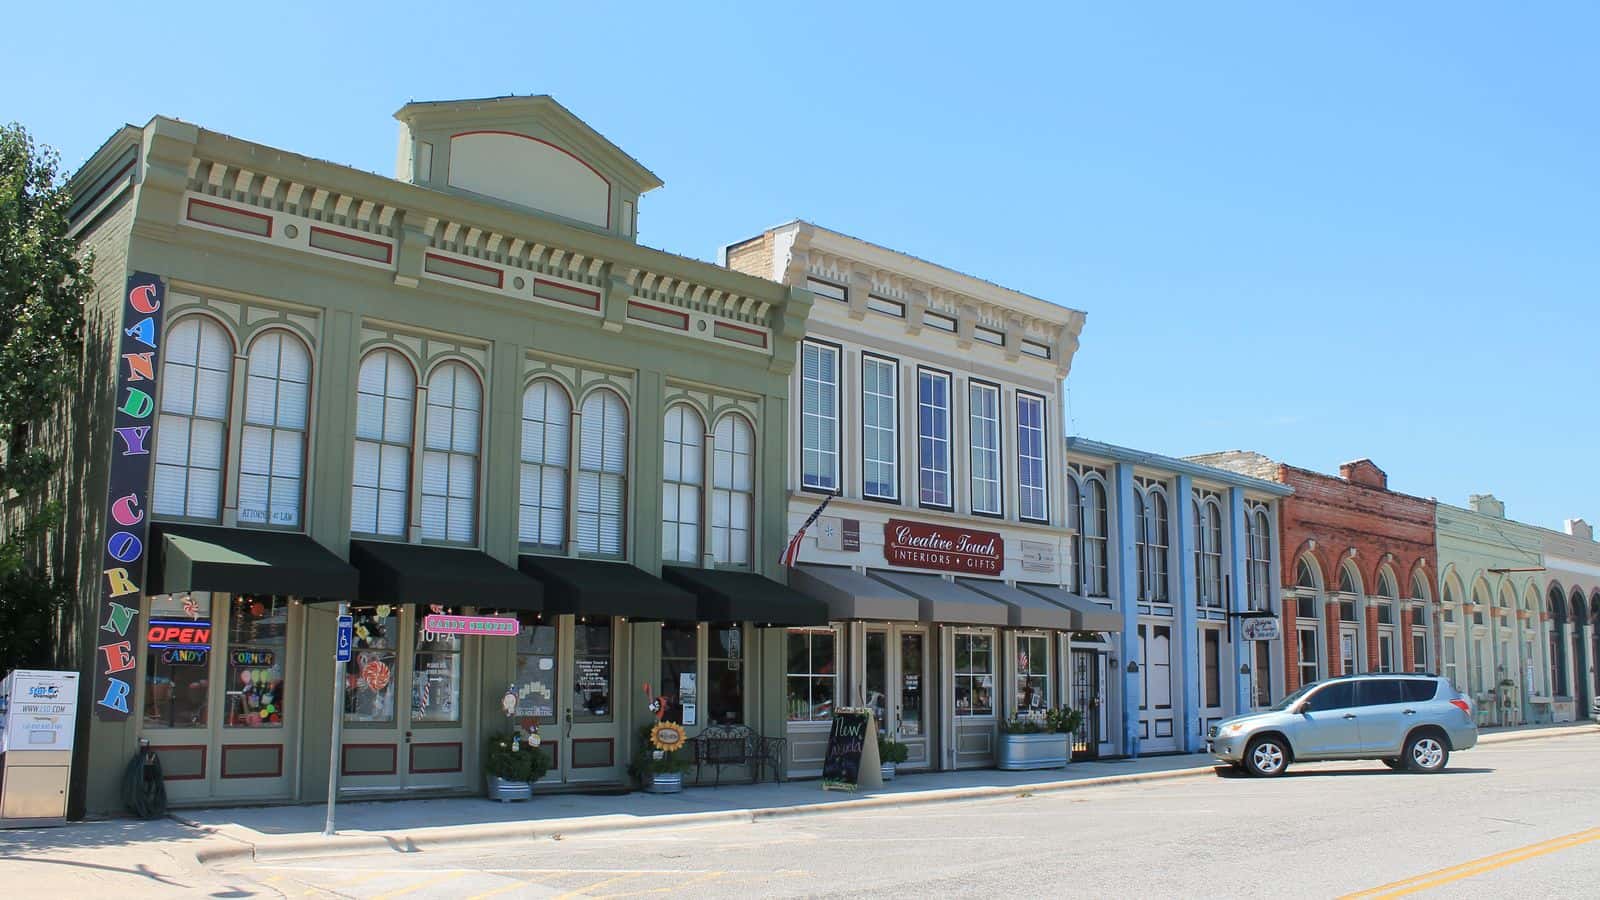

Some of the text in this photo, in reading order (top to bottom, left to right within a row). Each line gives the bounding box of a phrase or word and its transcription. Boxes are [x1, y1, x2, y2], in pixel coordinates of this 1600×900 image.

[114, 283, 160, 456] CANDY
[895, 525, 995, 555] Creative Touch
[894, 549, 996, 570] INTERIORS GIFTS
[97, 493, 144, 713] CORNER
[147, 627, 210, 643] OPEN
[162, 649, 205, 664] CANDY
[231, 650, 274, 665] CORNER
